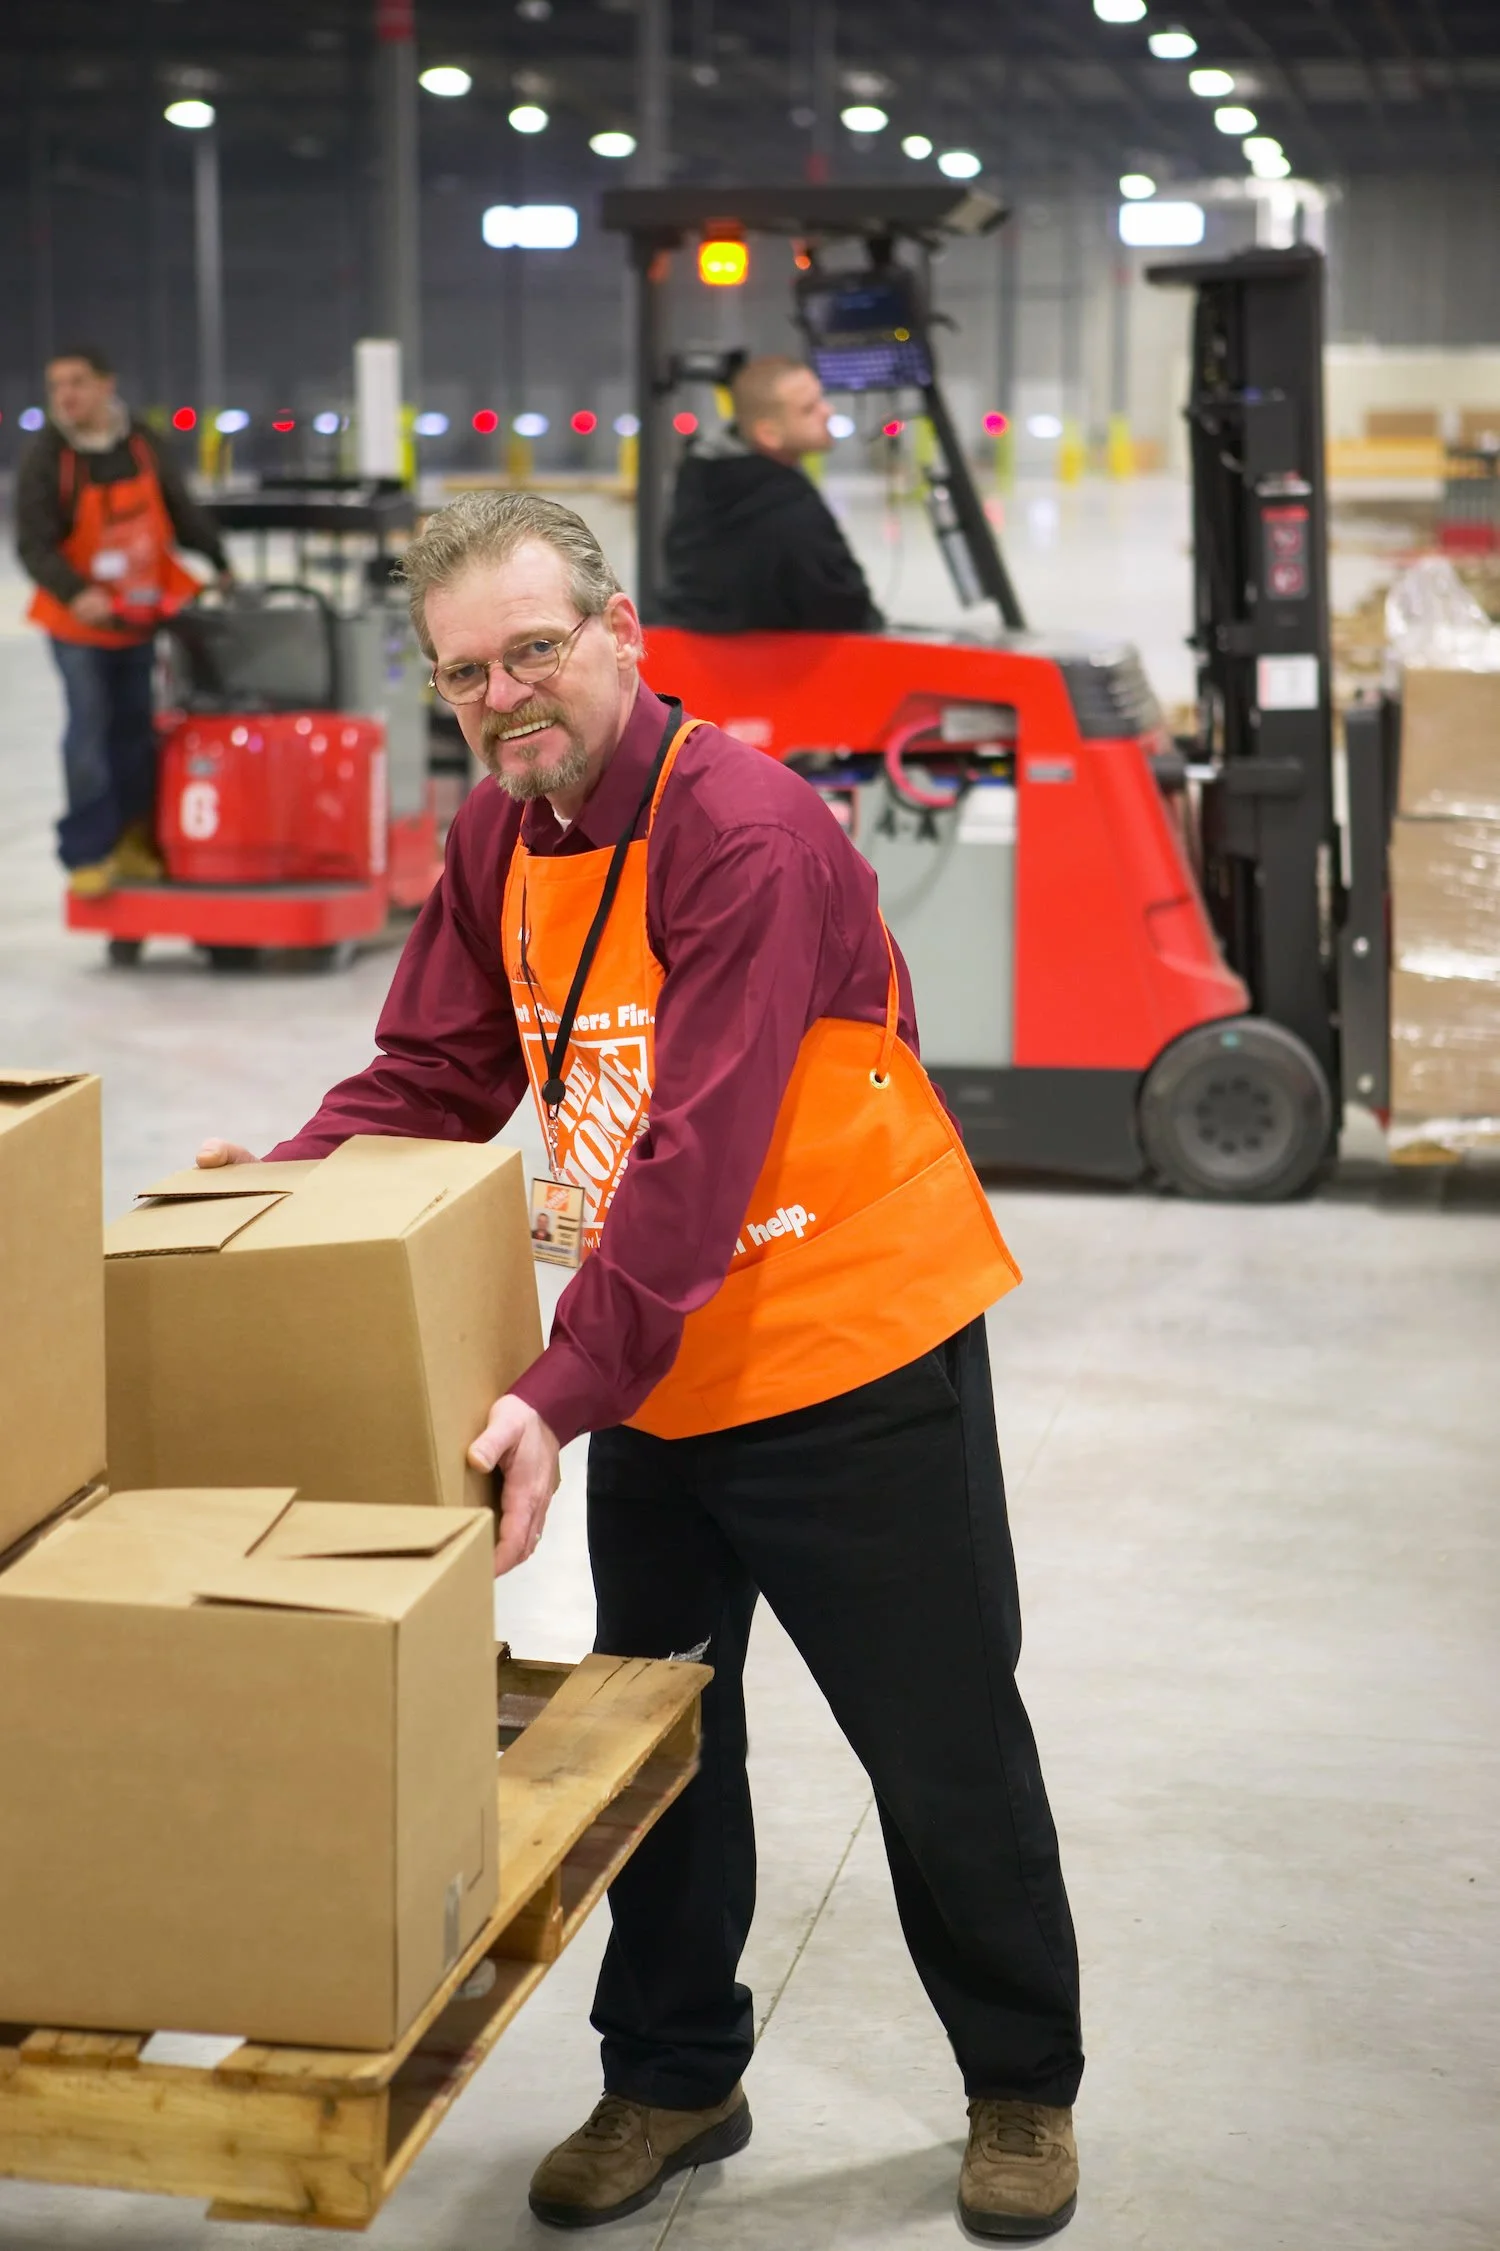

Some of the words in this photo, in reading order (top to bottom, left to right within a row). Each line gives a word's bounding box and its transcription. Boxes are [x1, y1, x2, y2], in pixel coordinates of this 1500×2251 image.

[551, 1056, 596, 1133] THE
[560, 1045, 653, 1223] HOME
[746, 1204, 816, 1247] help.
